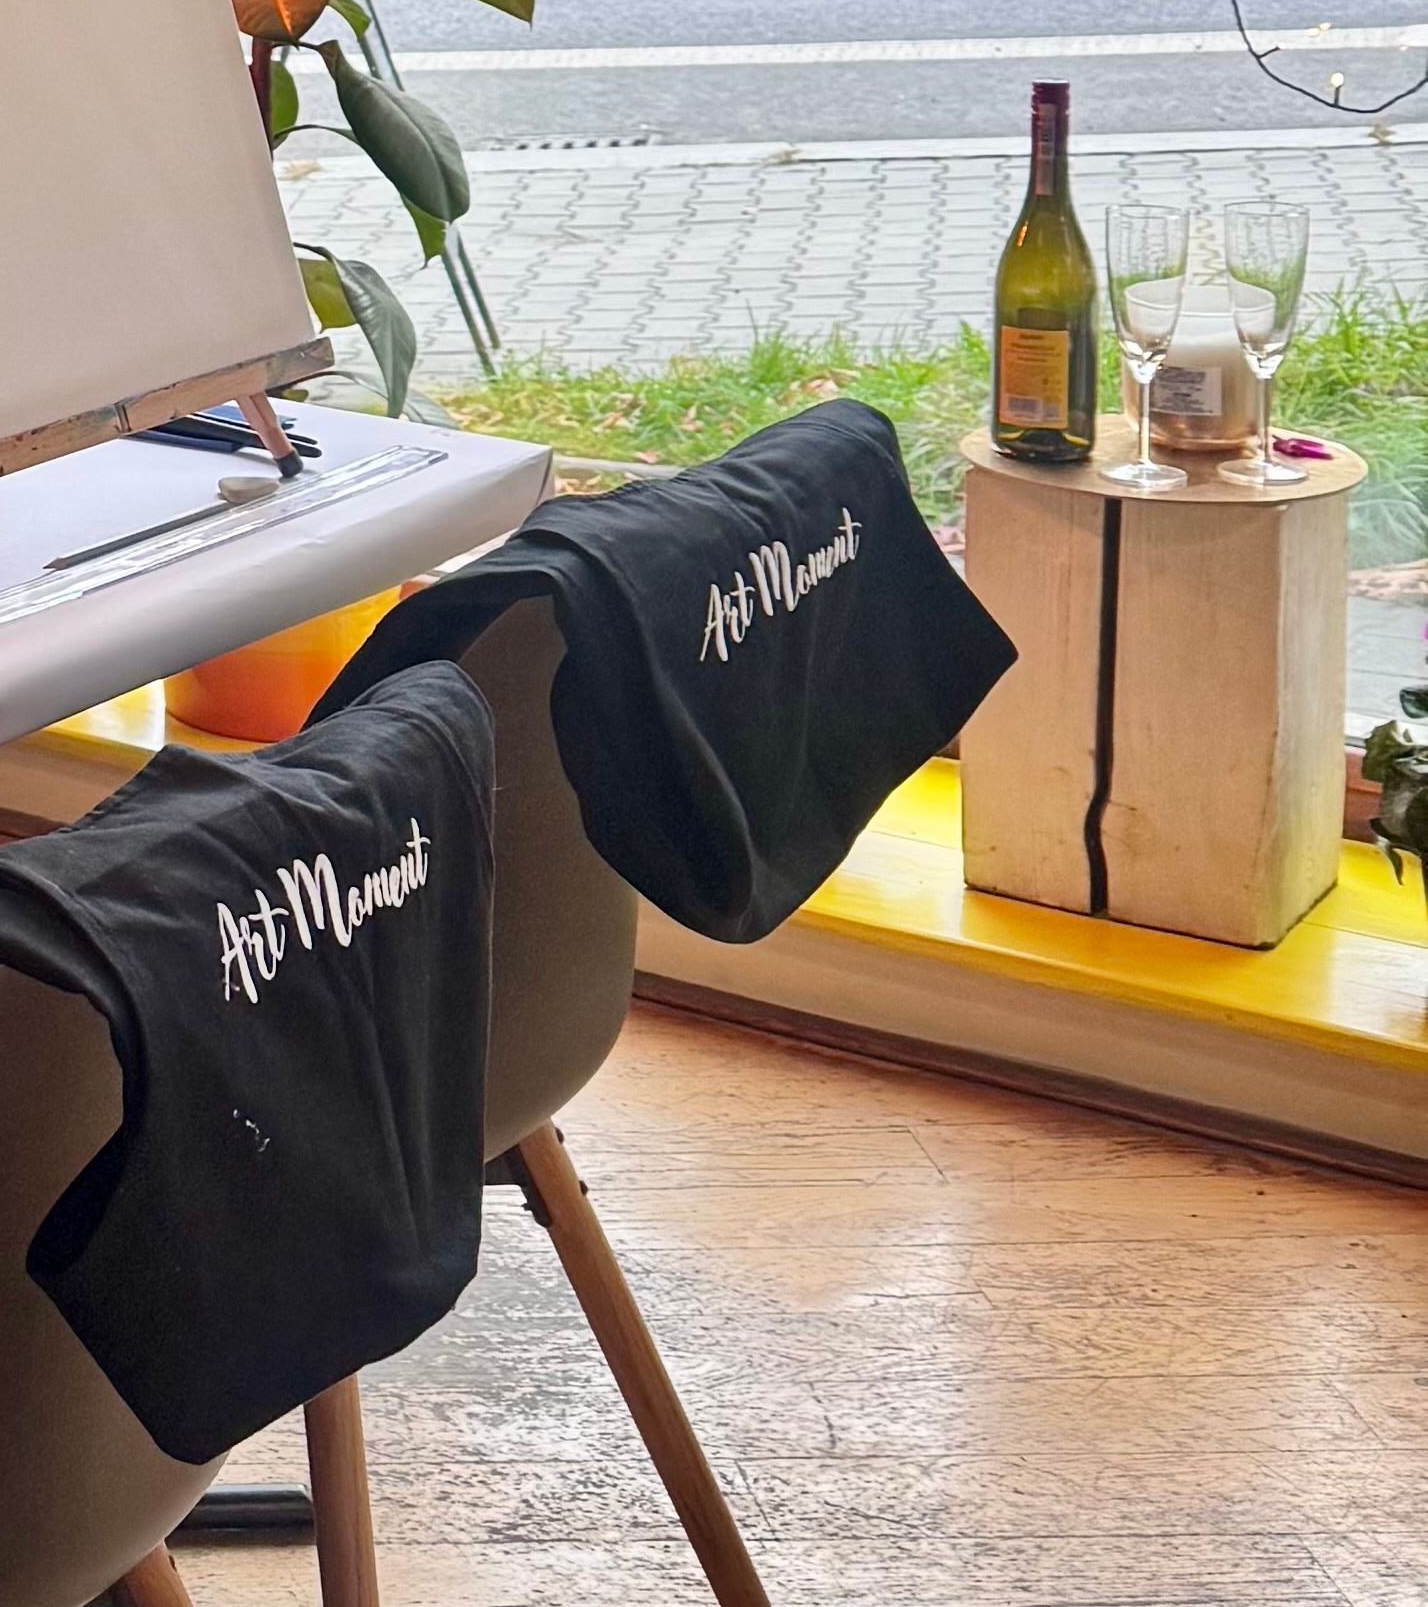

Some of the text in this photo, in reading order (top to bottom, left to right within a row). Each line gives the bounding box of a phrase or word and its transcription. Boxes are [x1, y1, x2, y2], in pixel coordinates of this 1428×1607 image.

[699, 506, 862, 661] Art Moment
[216, 816, 431, 1004] Art Moment
